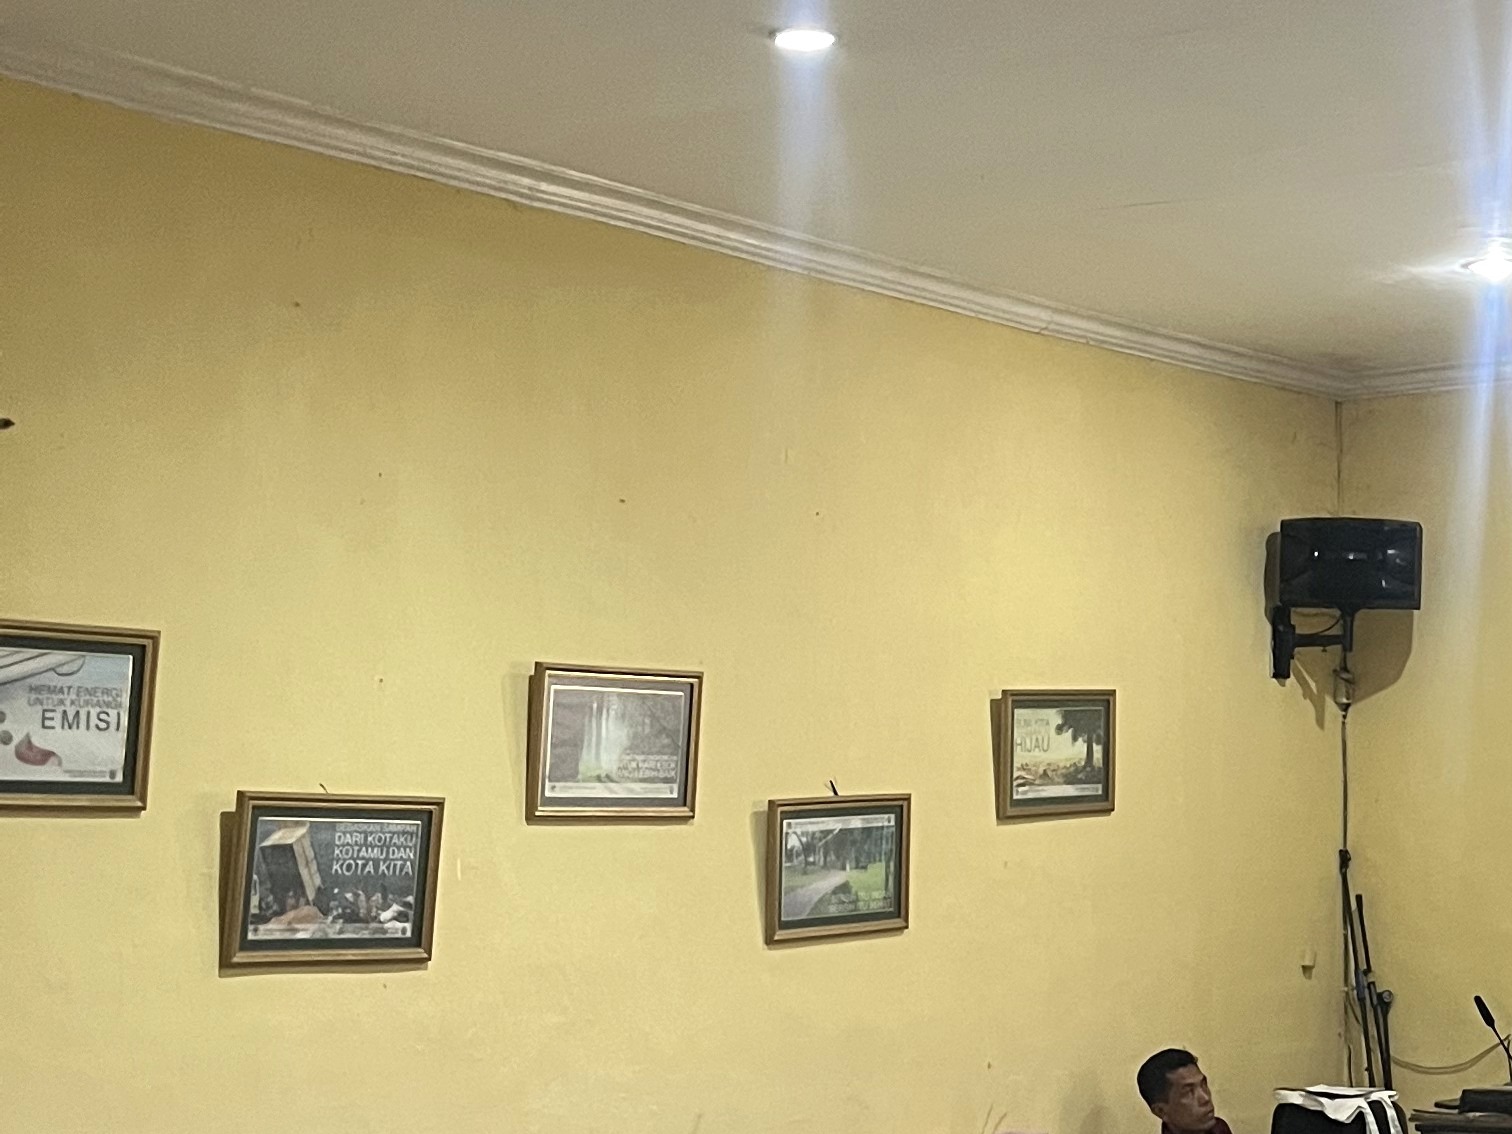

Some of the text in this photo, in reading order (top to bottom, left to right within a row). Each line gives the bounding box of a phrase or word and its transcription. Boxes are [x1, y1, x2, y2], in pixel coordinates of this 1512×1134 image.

[41, 709, 120, 731] EMISI
[335, 832, 416, 846] DARI KOTAKU
[334, 846, 415, 860] KOTAMU DAN
[332, 860, 413, 876] KOTA KITA
